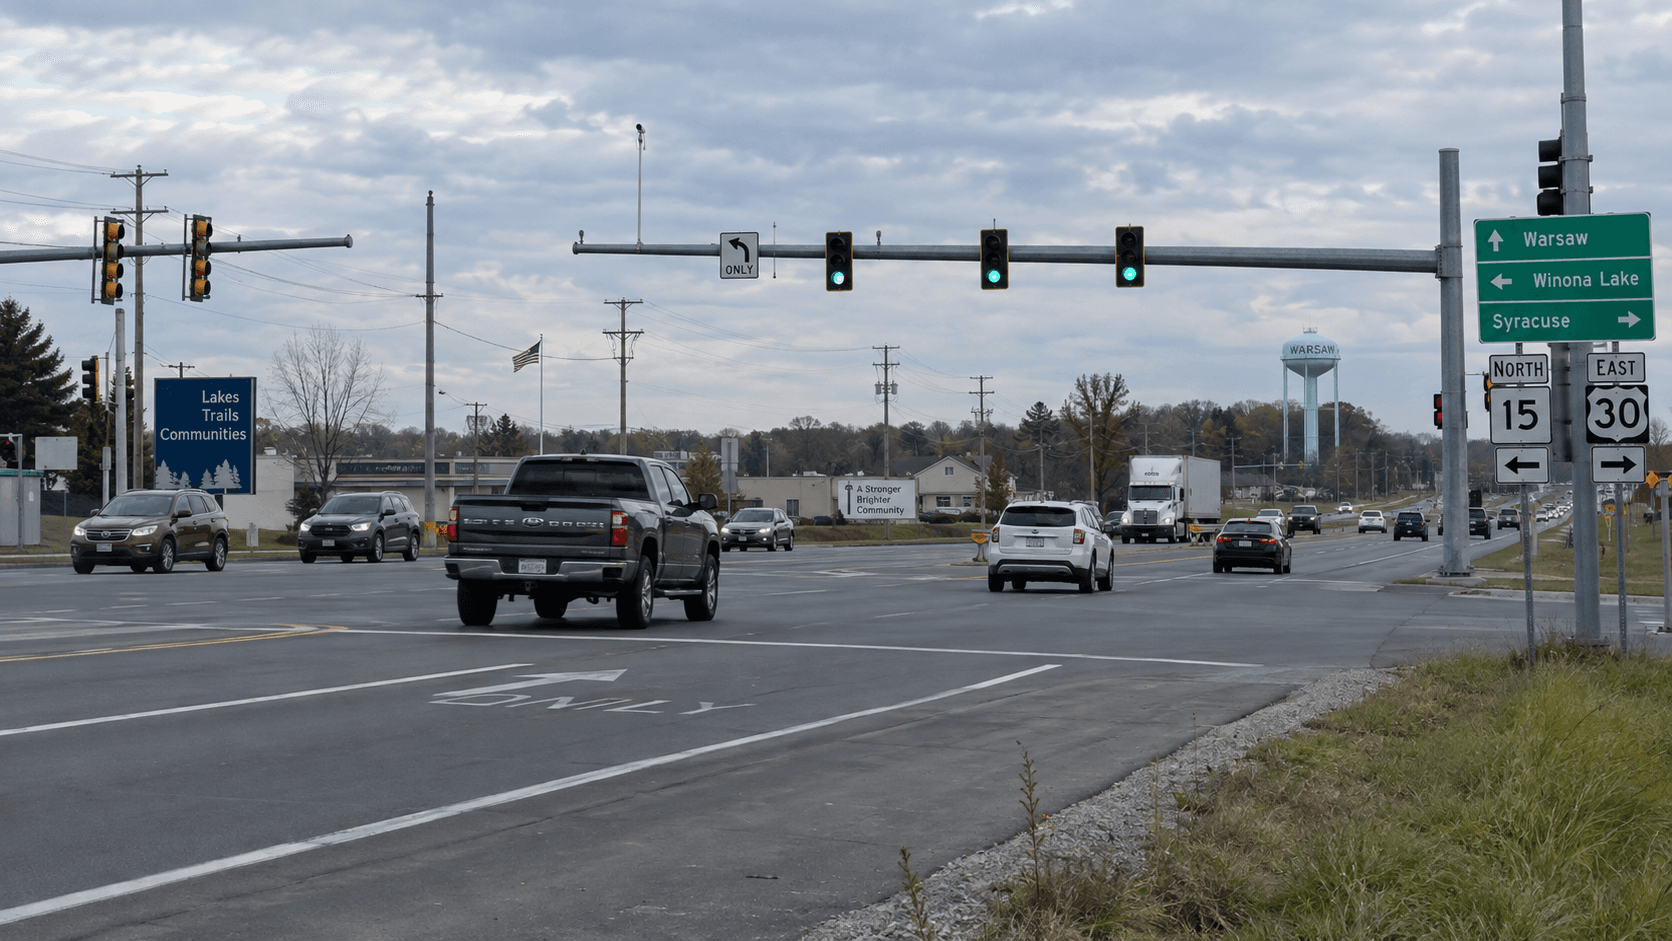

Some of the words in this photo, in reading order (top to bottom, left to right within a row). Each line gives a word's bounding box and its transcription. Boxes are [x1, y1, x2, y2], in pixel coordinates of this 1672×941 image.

[1523, 231, 1588, 247] Warsaw
[725, 265, 753, 275] ONLY
[1533, 272, 1592, 288] Winona
[1600, 271, 1639, 286] Lake
[1493, 313, 1571, 333] Syracuse
[1290, 345, 1335, 354] WARSAW
[1494, 360, 1543, 378] NORTH
[1597, 359, 1636, 376] EAST
[202, 390, 239, 403] Lakes
[202, 408, 239, 421] Trails
[1502, 399, 1538, 430] 15
[1594, 397, 1640, 429] 30
[160, 427, 247, 440] Communities
[857, 485, 863, 493] A
[865, 485, 901, 494] Stronger
[856, 495, 891, 505] Brighter
[856, 505, 904, 515] Community
